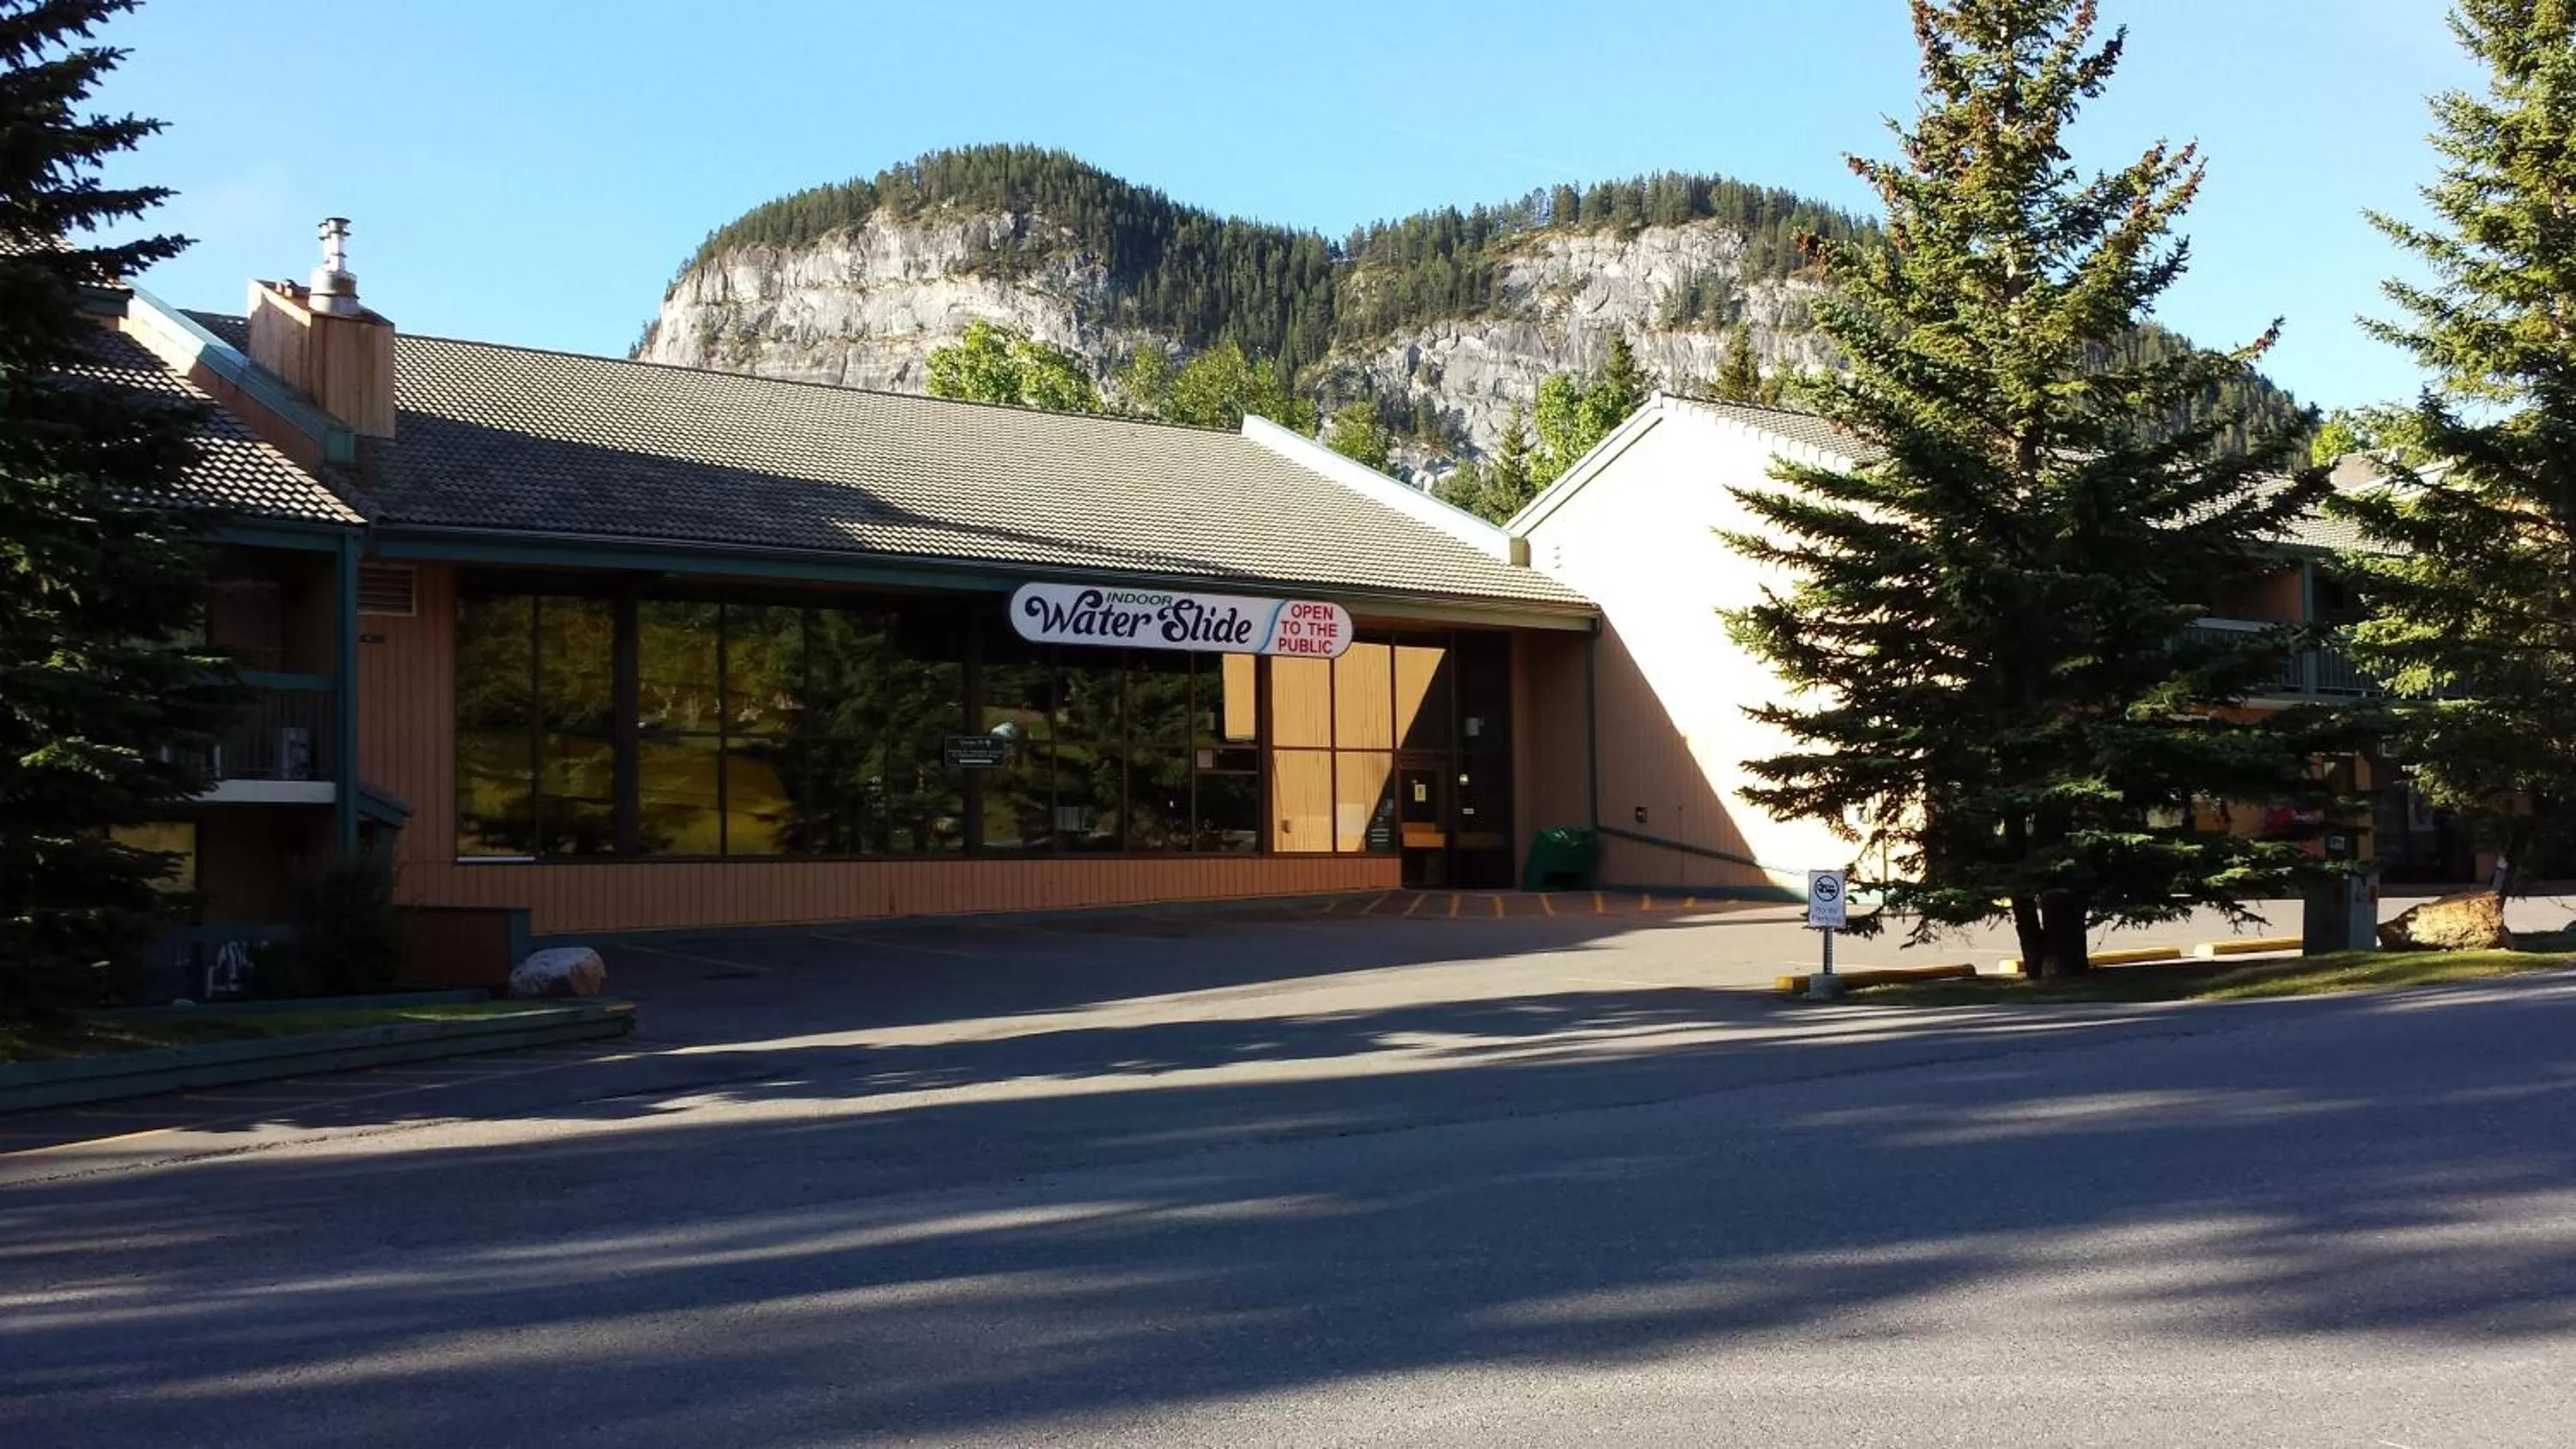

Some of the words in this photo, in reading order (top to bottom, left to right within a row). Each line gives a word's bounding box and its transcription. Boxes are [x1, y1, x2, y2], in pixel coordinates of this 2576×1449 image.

[1106, 591, 1174, 607] INDOOR
[1024, 589, 1152, 638] Water
[1157, 598, 1253, 645] Slide
[1291, 603, 1334, 620] OPEN
[1280, 621, 1301, 635] TO
[1306, 622, 1339, 637] THE
[1278, 637, 1333, 654] PUBLIC
